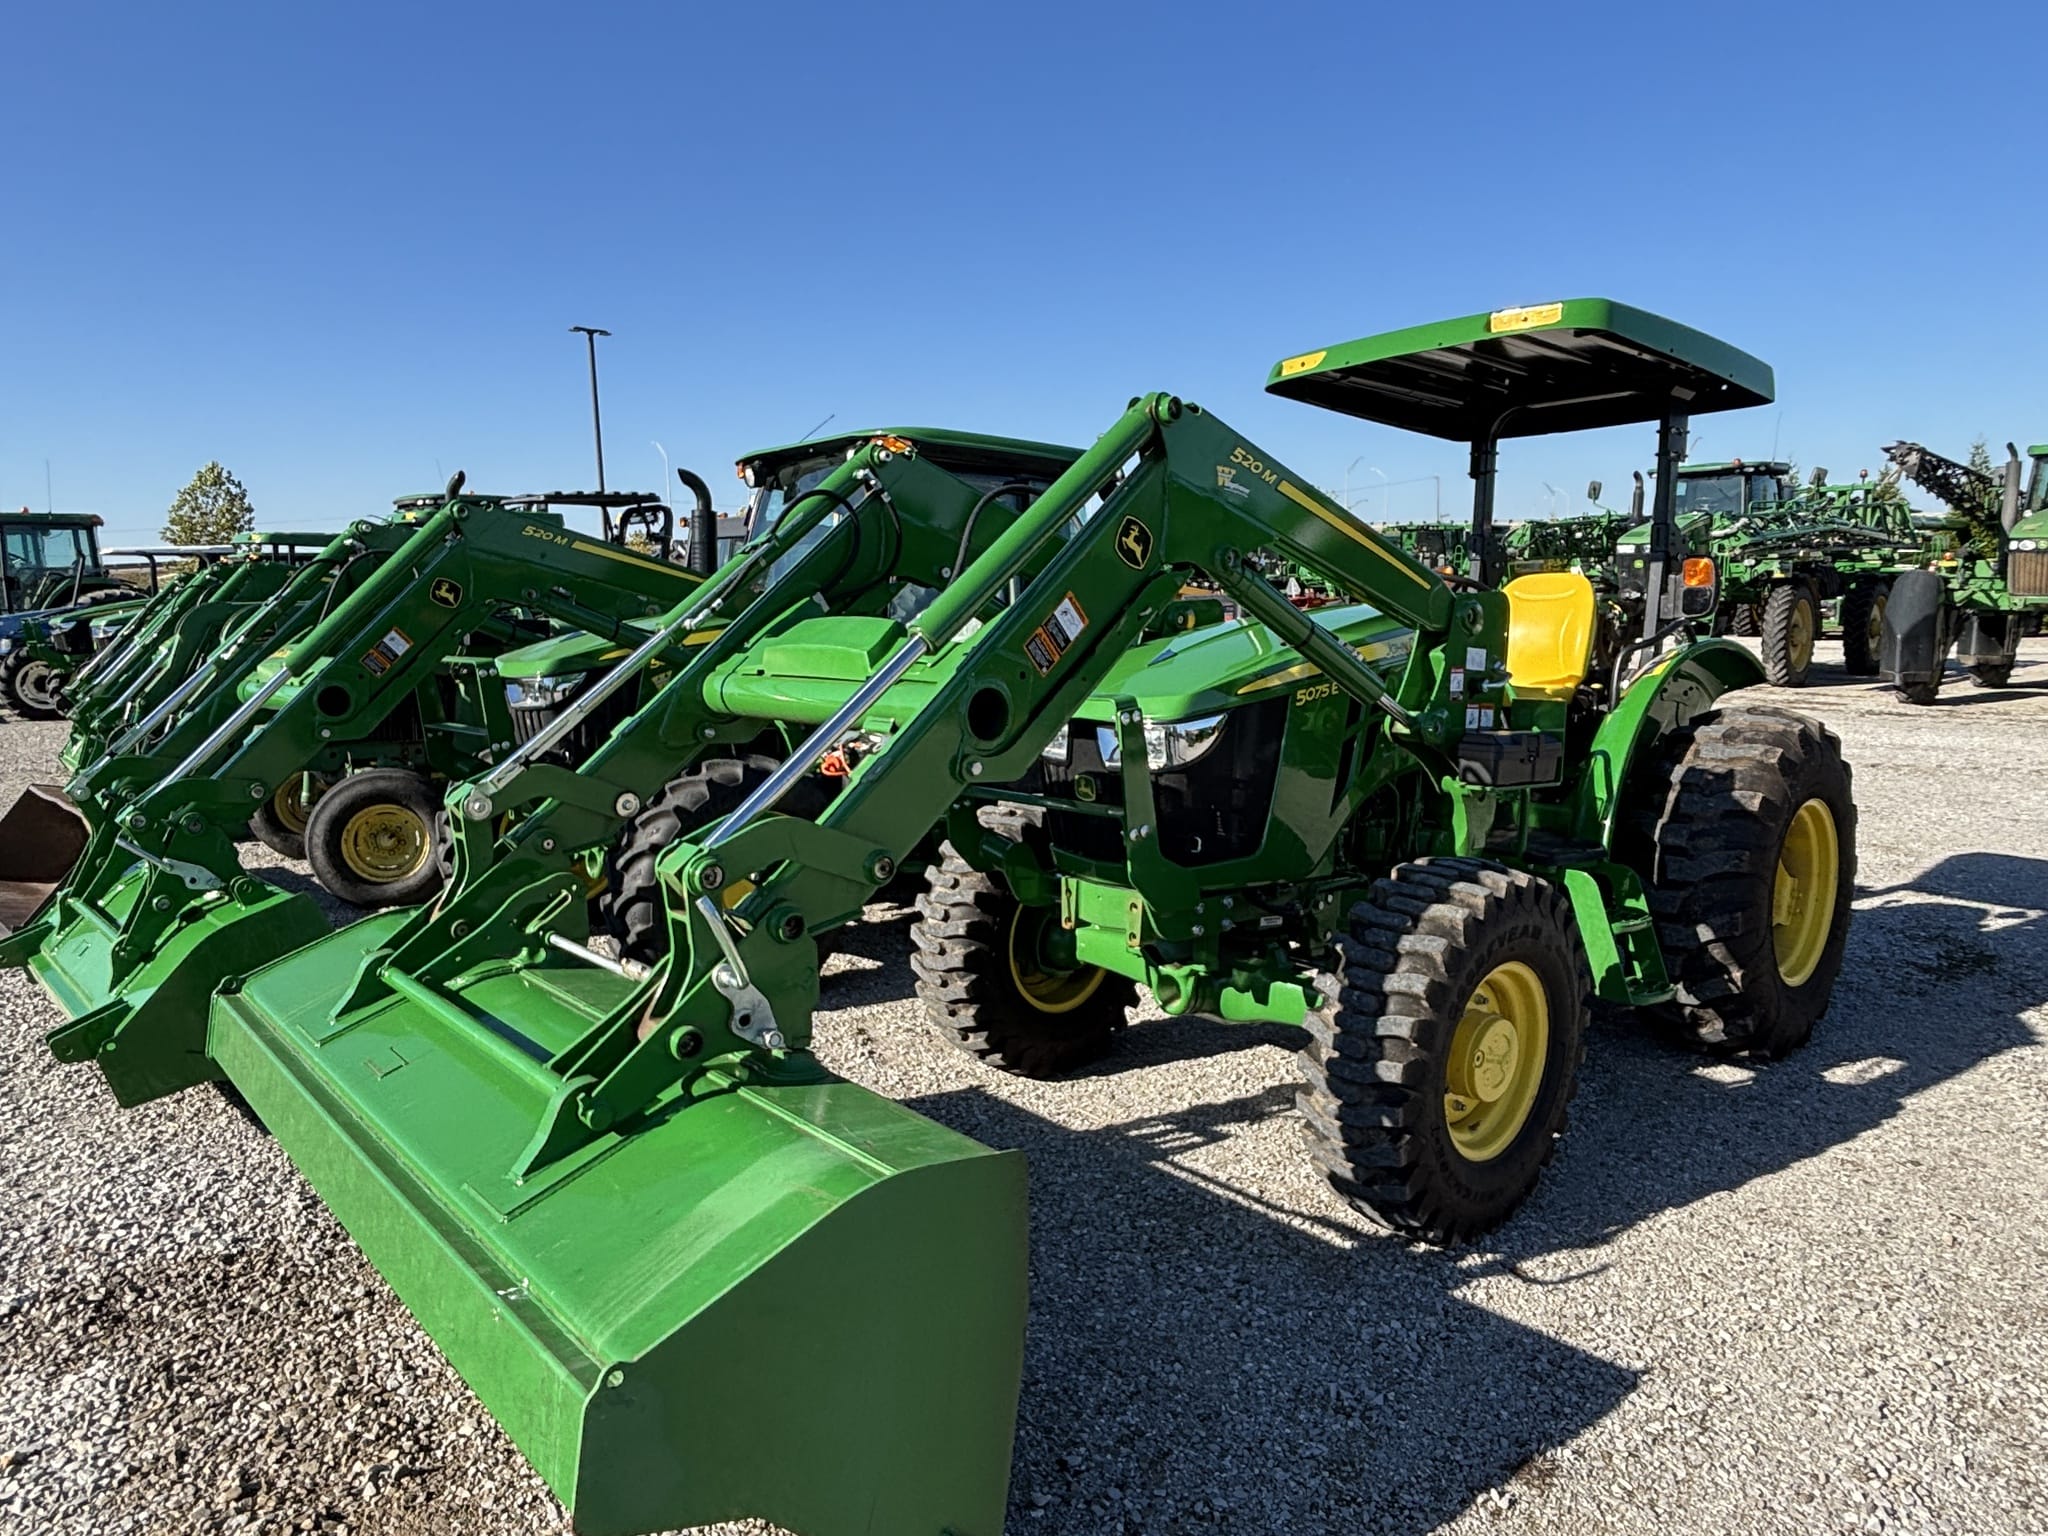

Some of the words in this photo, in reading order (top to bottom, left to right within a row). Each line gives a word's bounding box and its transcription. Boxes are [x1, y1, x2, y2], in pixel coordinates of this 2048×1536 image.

[1230, 447, 1263, 474] 520
[1261, 469, 1278, 485] M
[522, 525, 554, 540] 520
[553, 535, 568, 546] M
